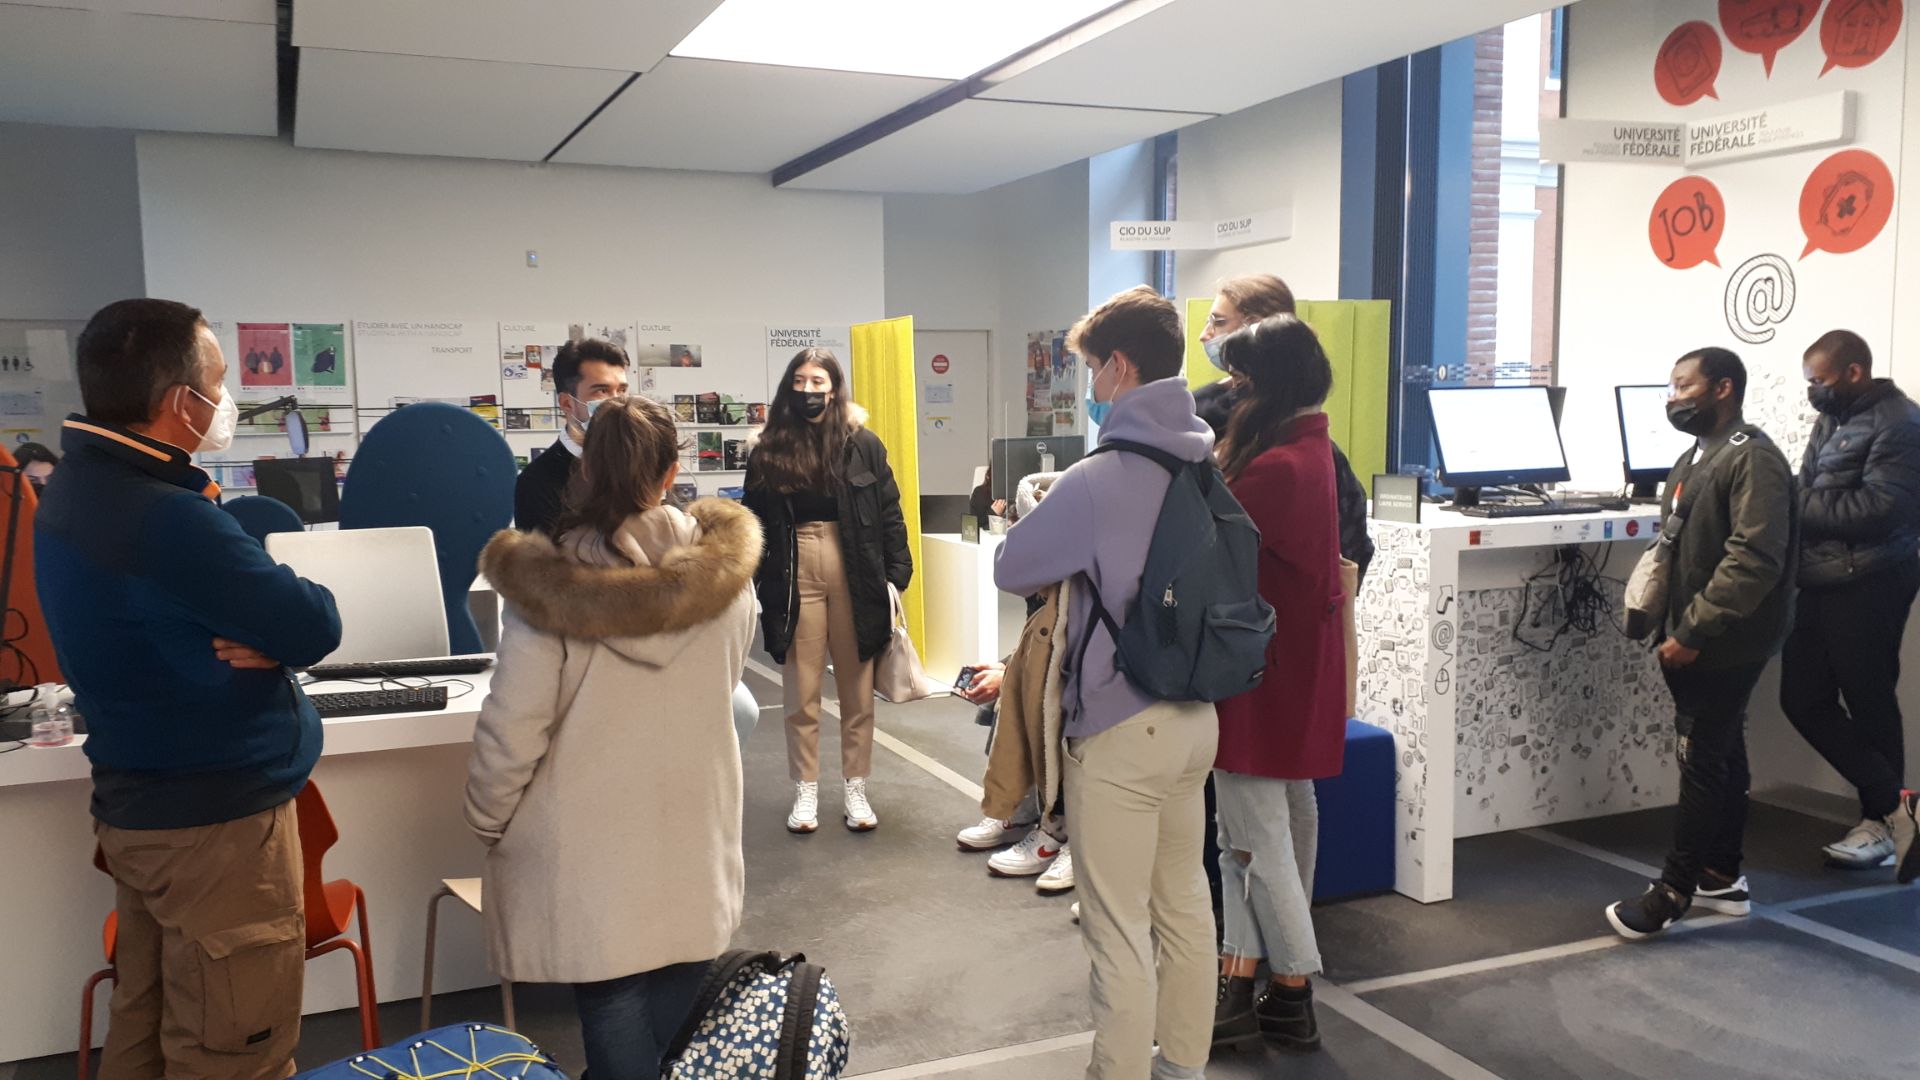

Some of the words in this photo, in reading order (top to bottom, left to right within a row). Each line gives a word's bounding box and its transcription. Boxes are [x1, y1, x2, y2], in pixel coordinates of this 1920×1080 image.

[1690, 111, 1768, 141] UNIVERSITÉ
[1613, 127, 1681, 142] UNIVERSITÉ
[1622, 141, 1681, 157] FÉDÉRALE
[1690, 132, 1757, 156] FÉDÉRALE
[1217, 222, 1229, 233] CIO
[1229, 220, 1239, 231] DU
[1240, 218, 1252, 229] SUP
[1119, 226, 1136, 236] CIO
[1137, 226, 1152, 236] DU
[1153, 226, 1172, 236] SUP
[503, 324, 536, 332] CULTURE
[641, 324, 672, 332] CULTURE
[770, 328, 821, 338] UNIVERSITÉ
[770, 338, 815, 348] FÉDÉRALE
[431, 346, 473, 354] TRANSPORT
